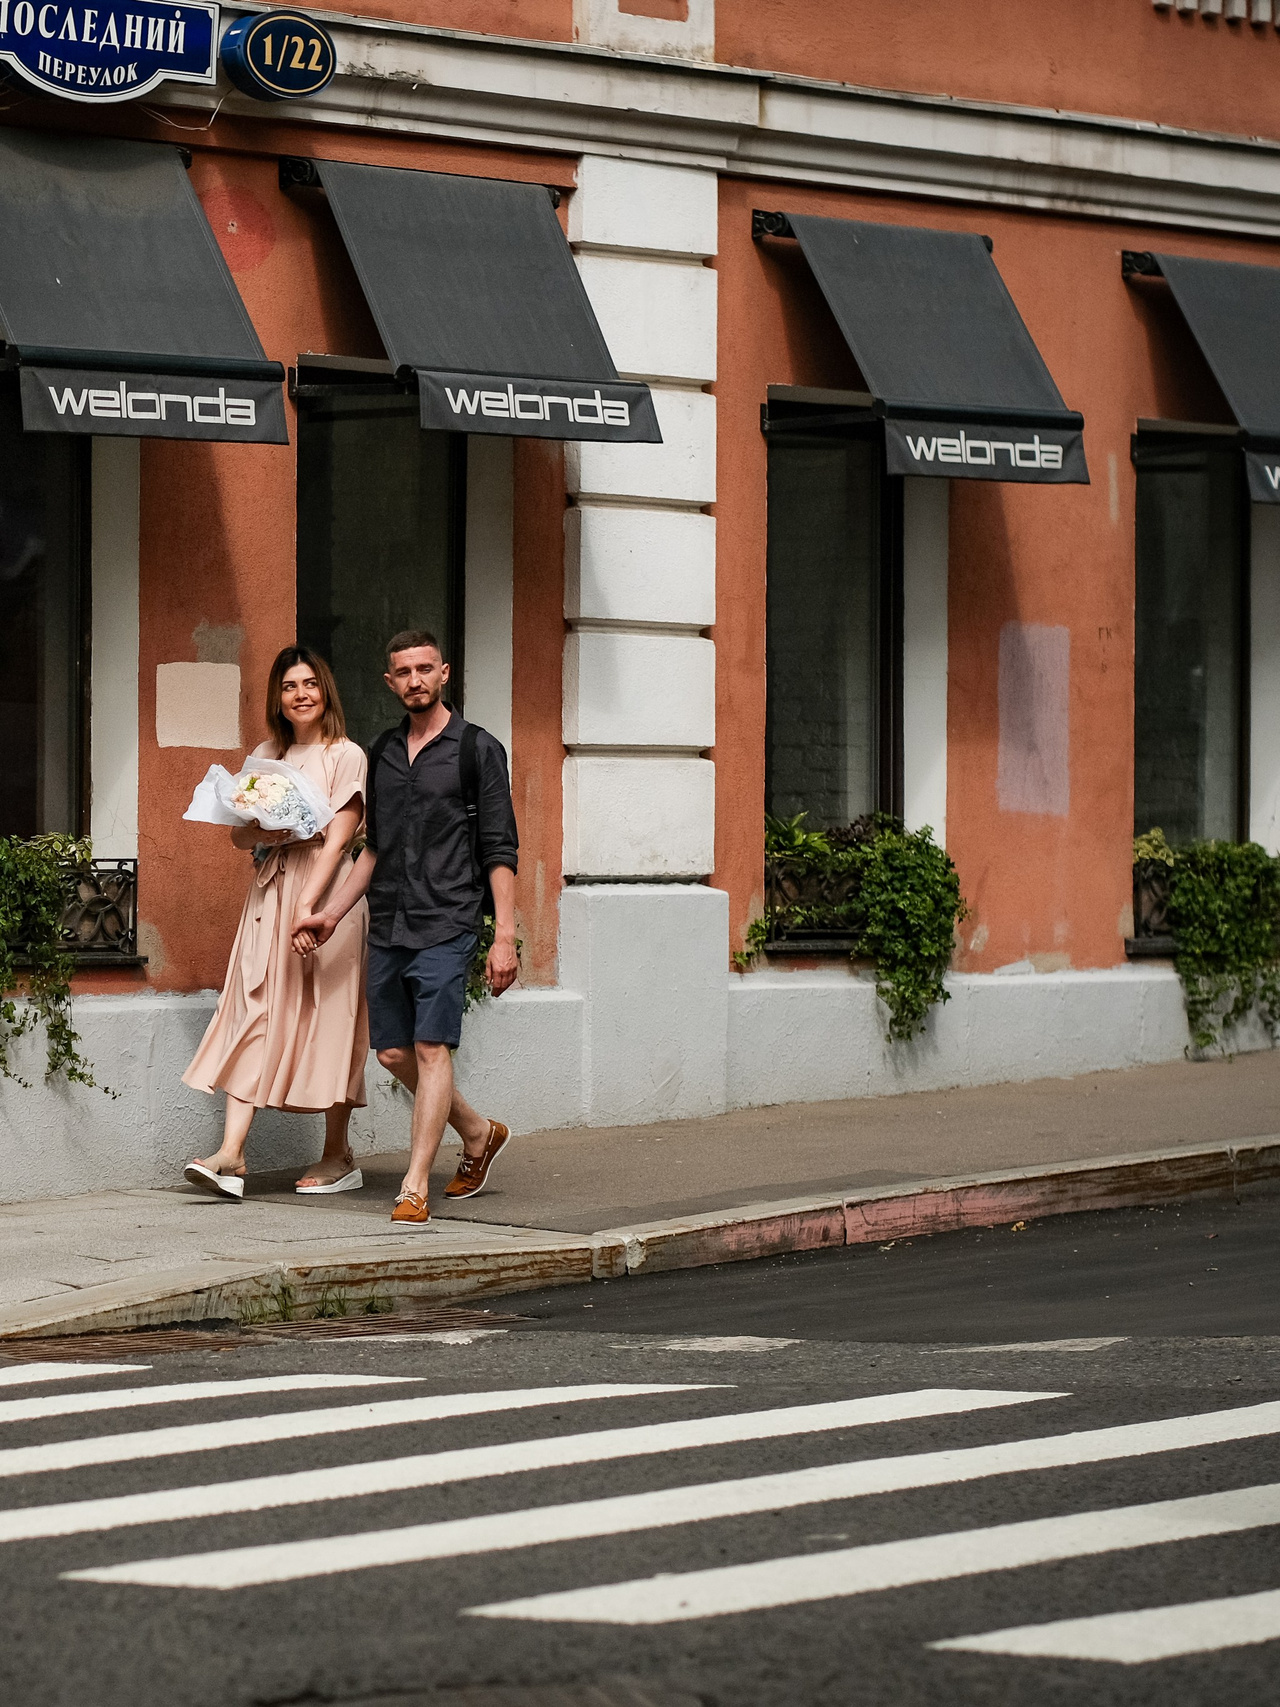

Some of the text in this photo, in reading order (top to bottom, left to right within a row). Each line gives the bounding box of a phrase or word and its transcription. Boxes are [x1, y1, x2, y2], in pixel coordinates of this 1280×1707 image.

[37, 51, 138, 87] ПЕРЕУЛОК
[263, 34, 323, 73] 1/22
[49, 381, 255, 426] welonda
[445, 384, 631, 427] welonda
[906, 430, 1063, 470] welonda
